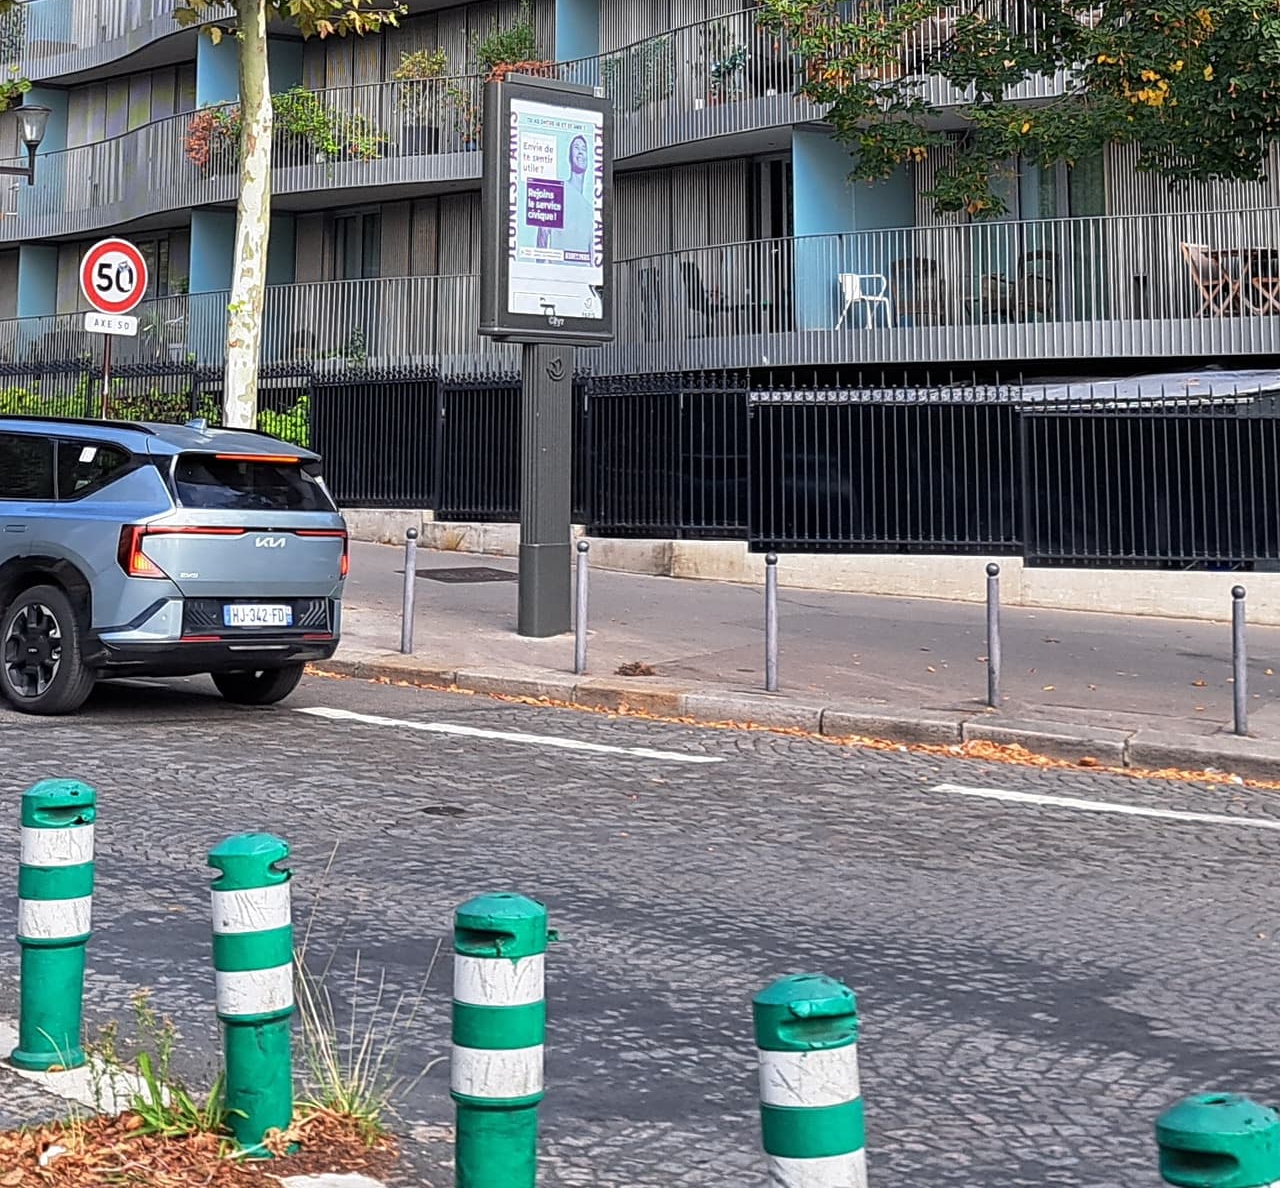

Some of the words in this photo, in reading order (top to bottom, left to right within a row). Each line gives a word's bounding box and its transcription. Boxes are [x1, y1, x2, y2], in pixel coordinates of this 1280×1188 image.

[523, 141, 543, 153] Envie
[544, 144, 554, 153] de
[523, 153, 530, 161] te
[532, 154, 553, 164] sentir
[523, 163, 539, 172] utile
[528, 188, 554, 200] Rejoins
[528, 199, 535, 208] le
[536, 200, 561, 210] service
[528, 210, 554, 222] civique
[96, 262, 133, 293] 50
[94, 318, 113, 329] AXE
[255, 537, 286, 548] KIA
[232, 607, 285, 623] HJ-342-FD
